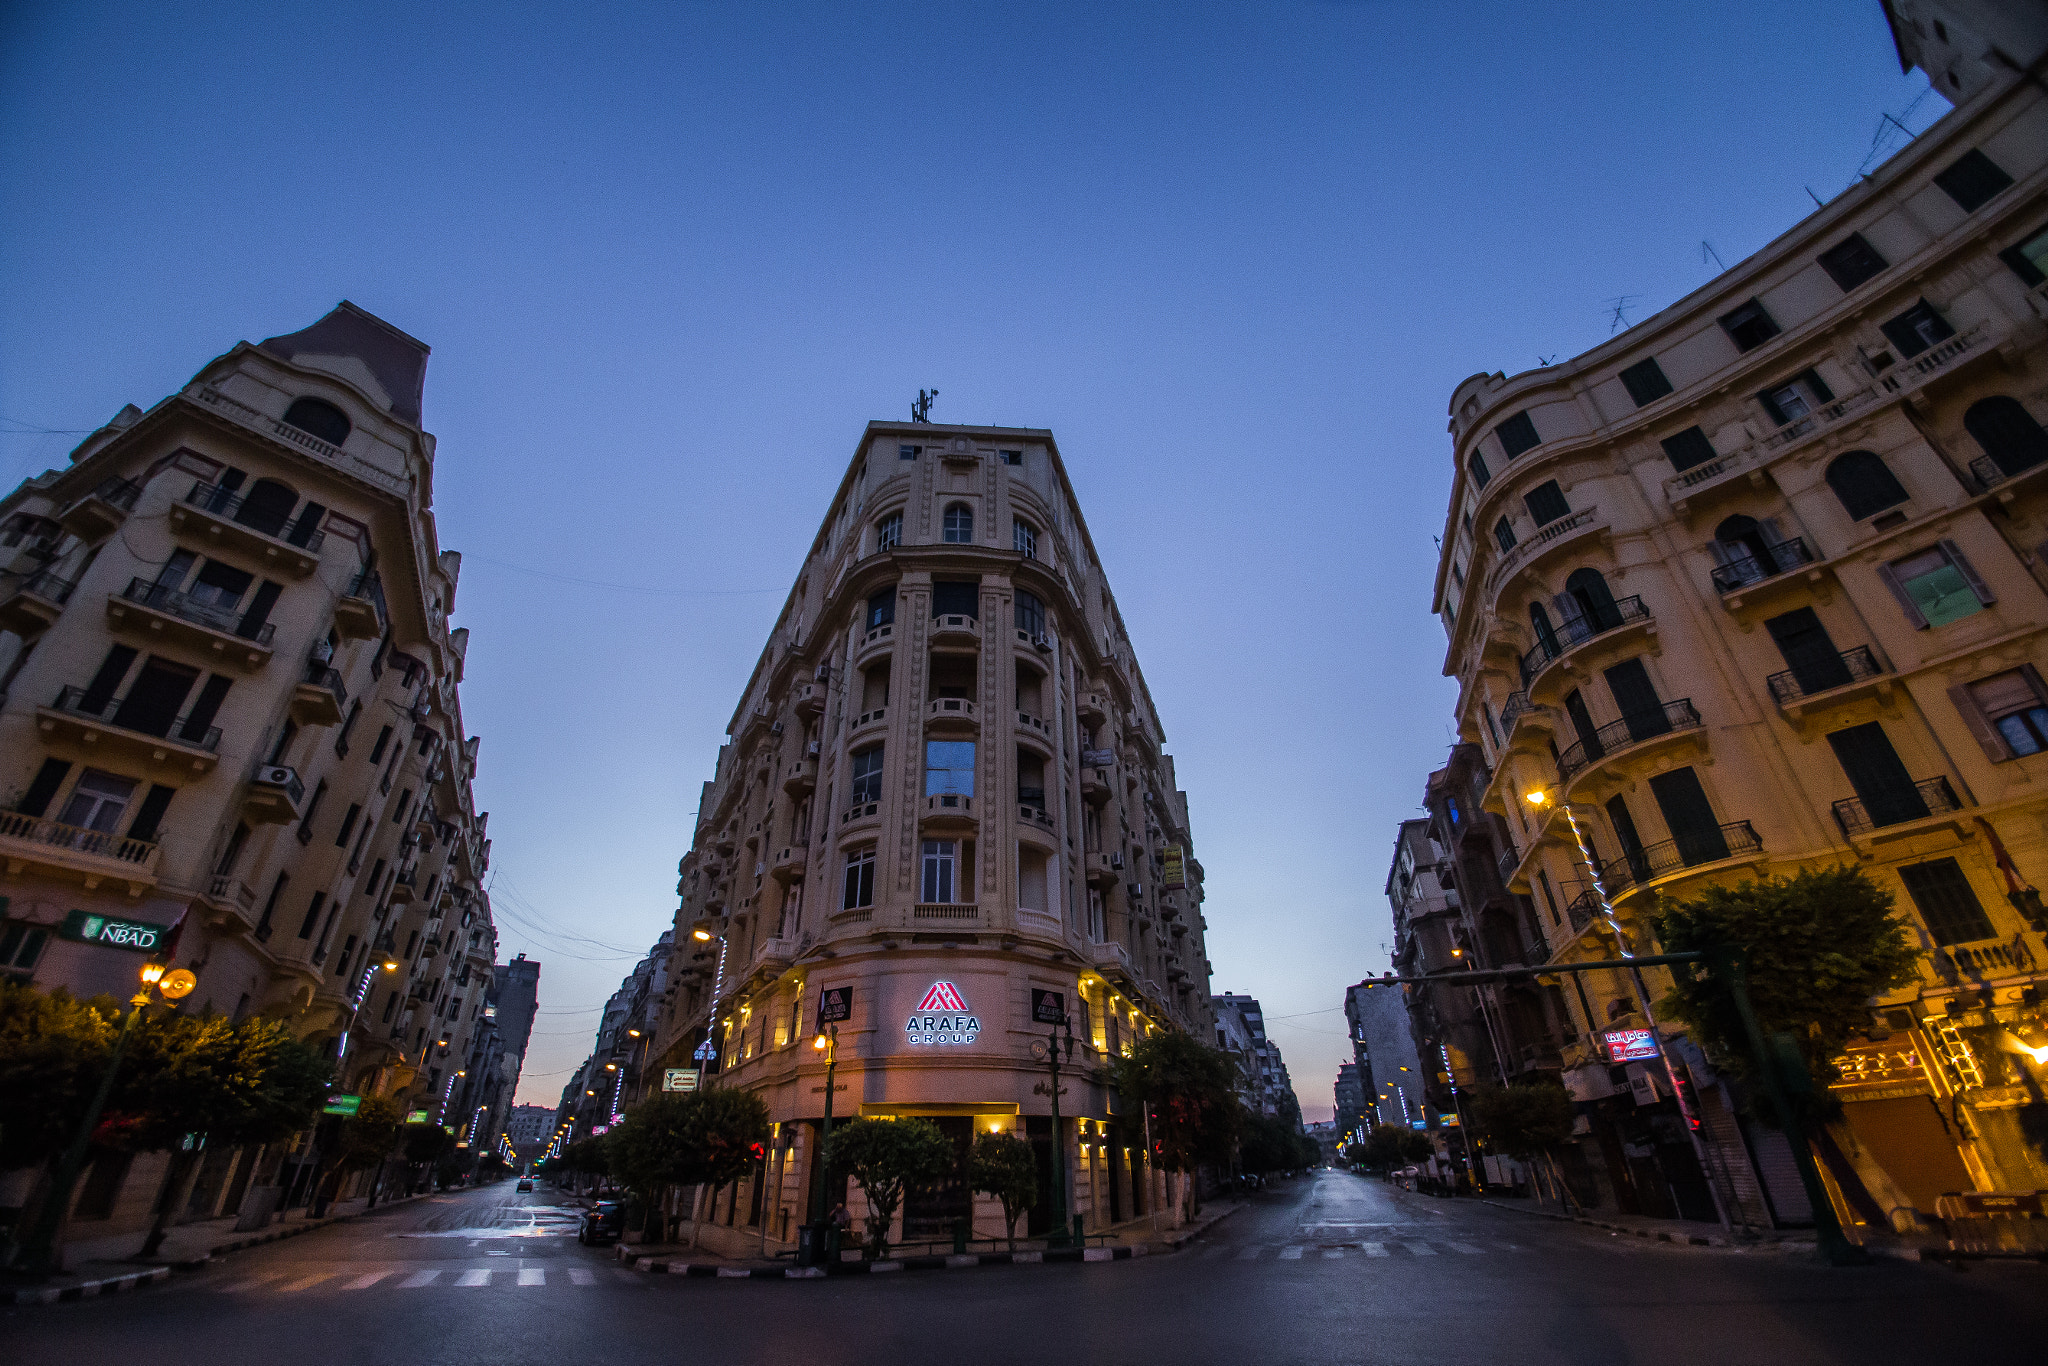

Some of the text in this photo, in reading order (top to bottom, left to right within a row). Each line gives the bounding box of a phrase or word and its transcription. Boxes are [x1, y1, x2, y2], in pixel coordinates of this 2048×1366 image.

[99, 927, 156, 947] NBAD
[906, 1016, 981, 1032] ARAFA
[909, 1034, 975, 1044] GROUP
